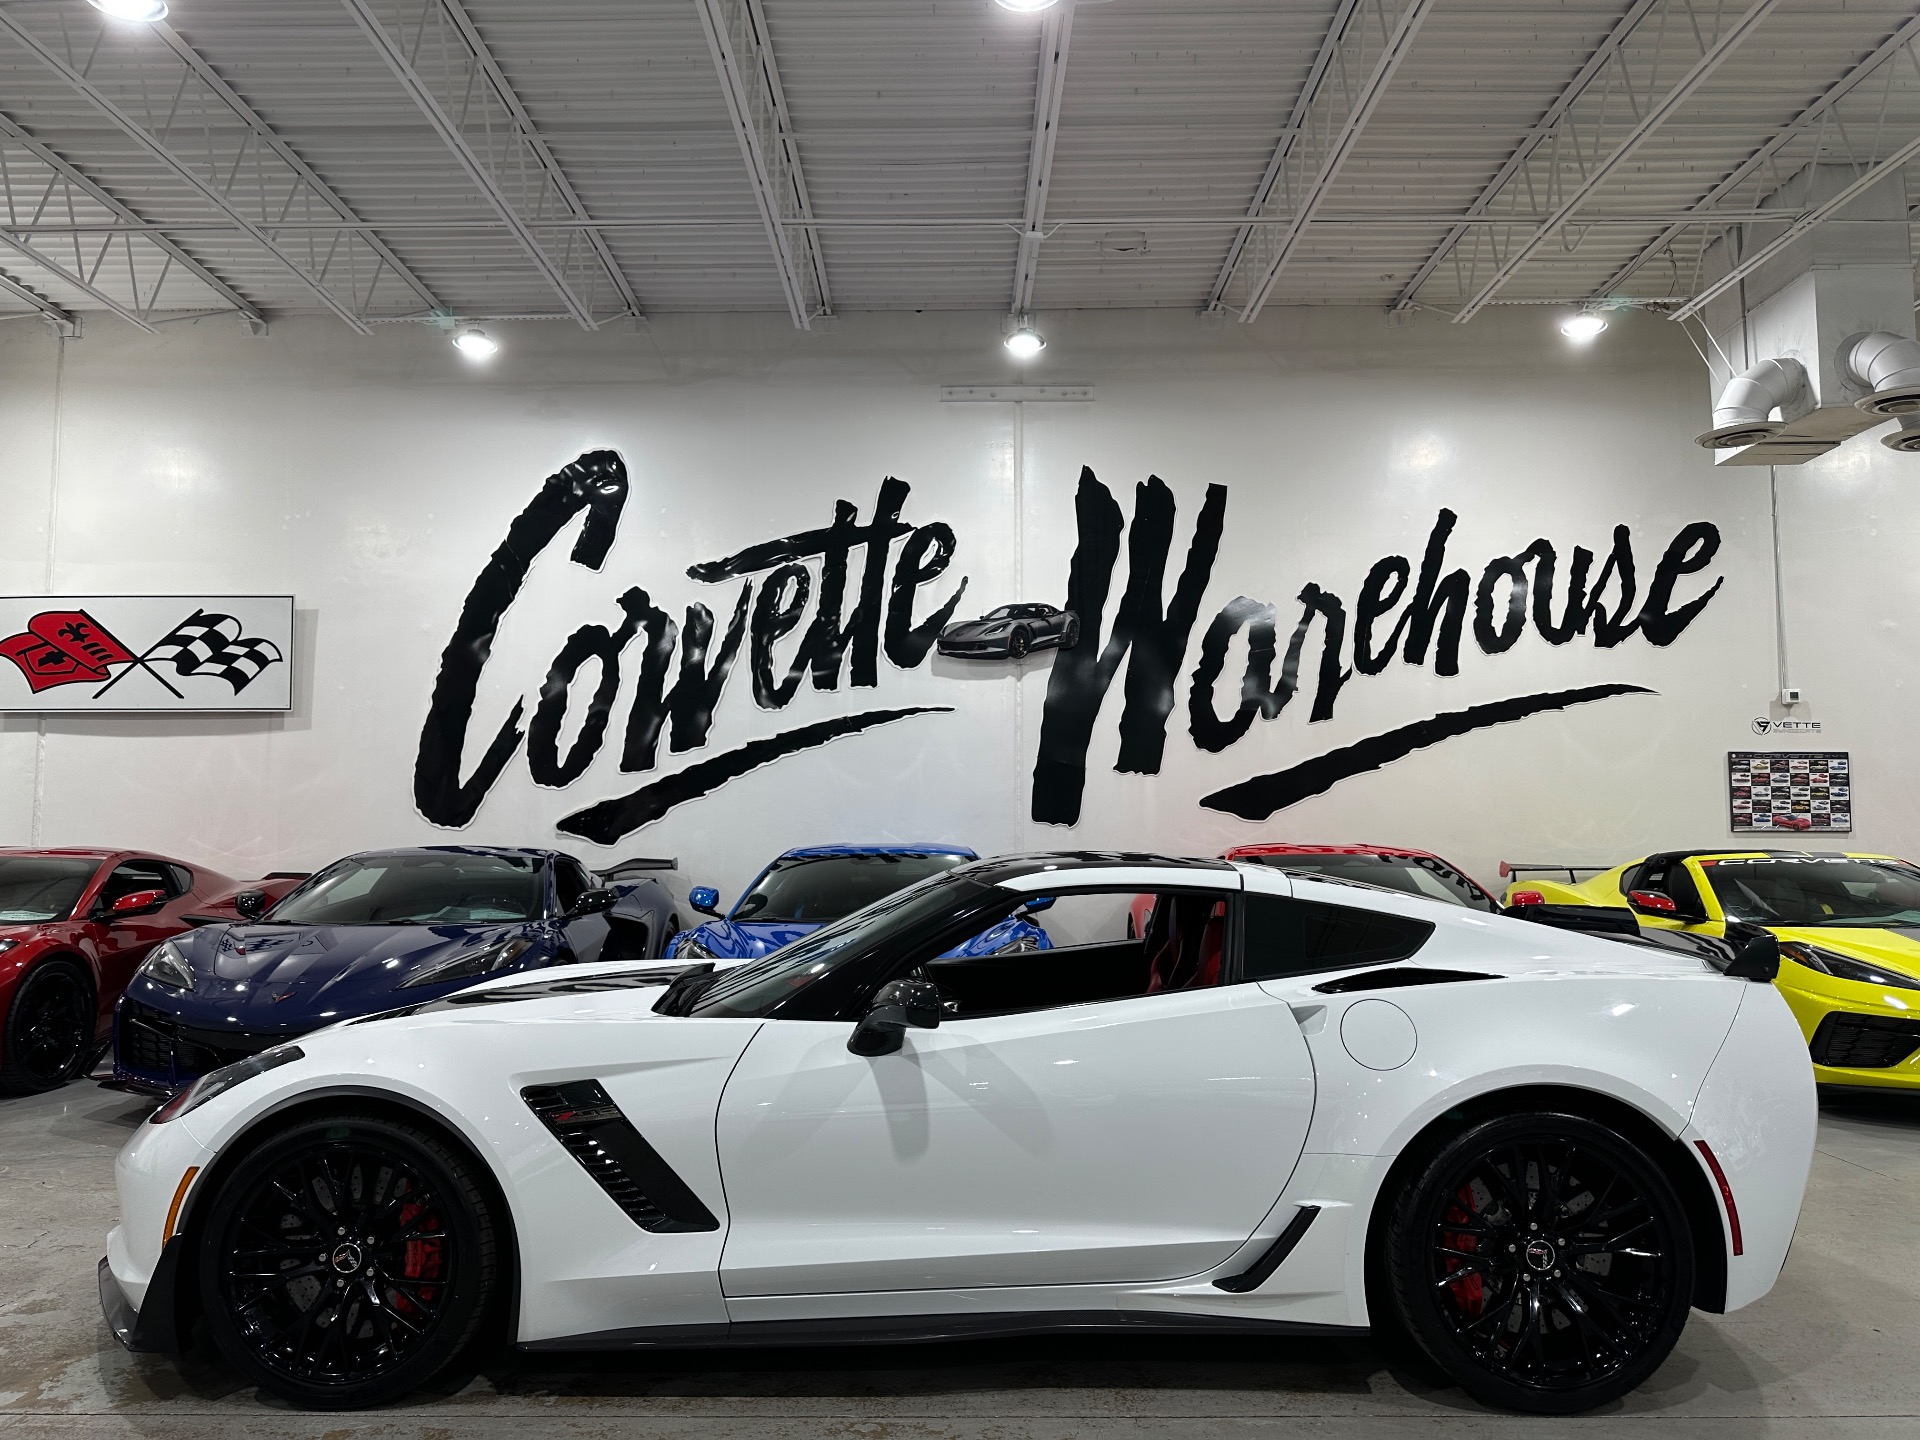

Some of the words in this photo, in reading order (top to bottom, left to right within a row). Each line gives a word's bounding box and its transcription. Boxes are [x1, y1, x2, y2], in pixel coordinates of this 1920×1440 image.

[413, 449, 968, 829] Corvette
[1031, 465, 1724, 828] Warehouse
[1772, 721, 1821, 729] VETTE
